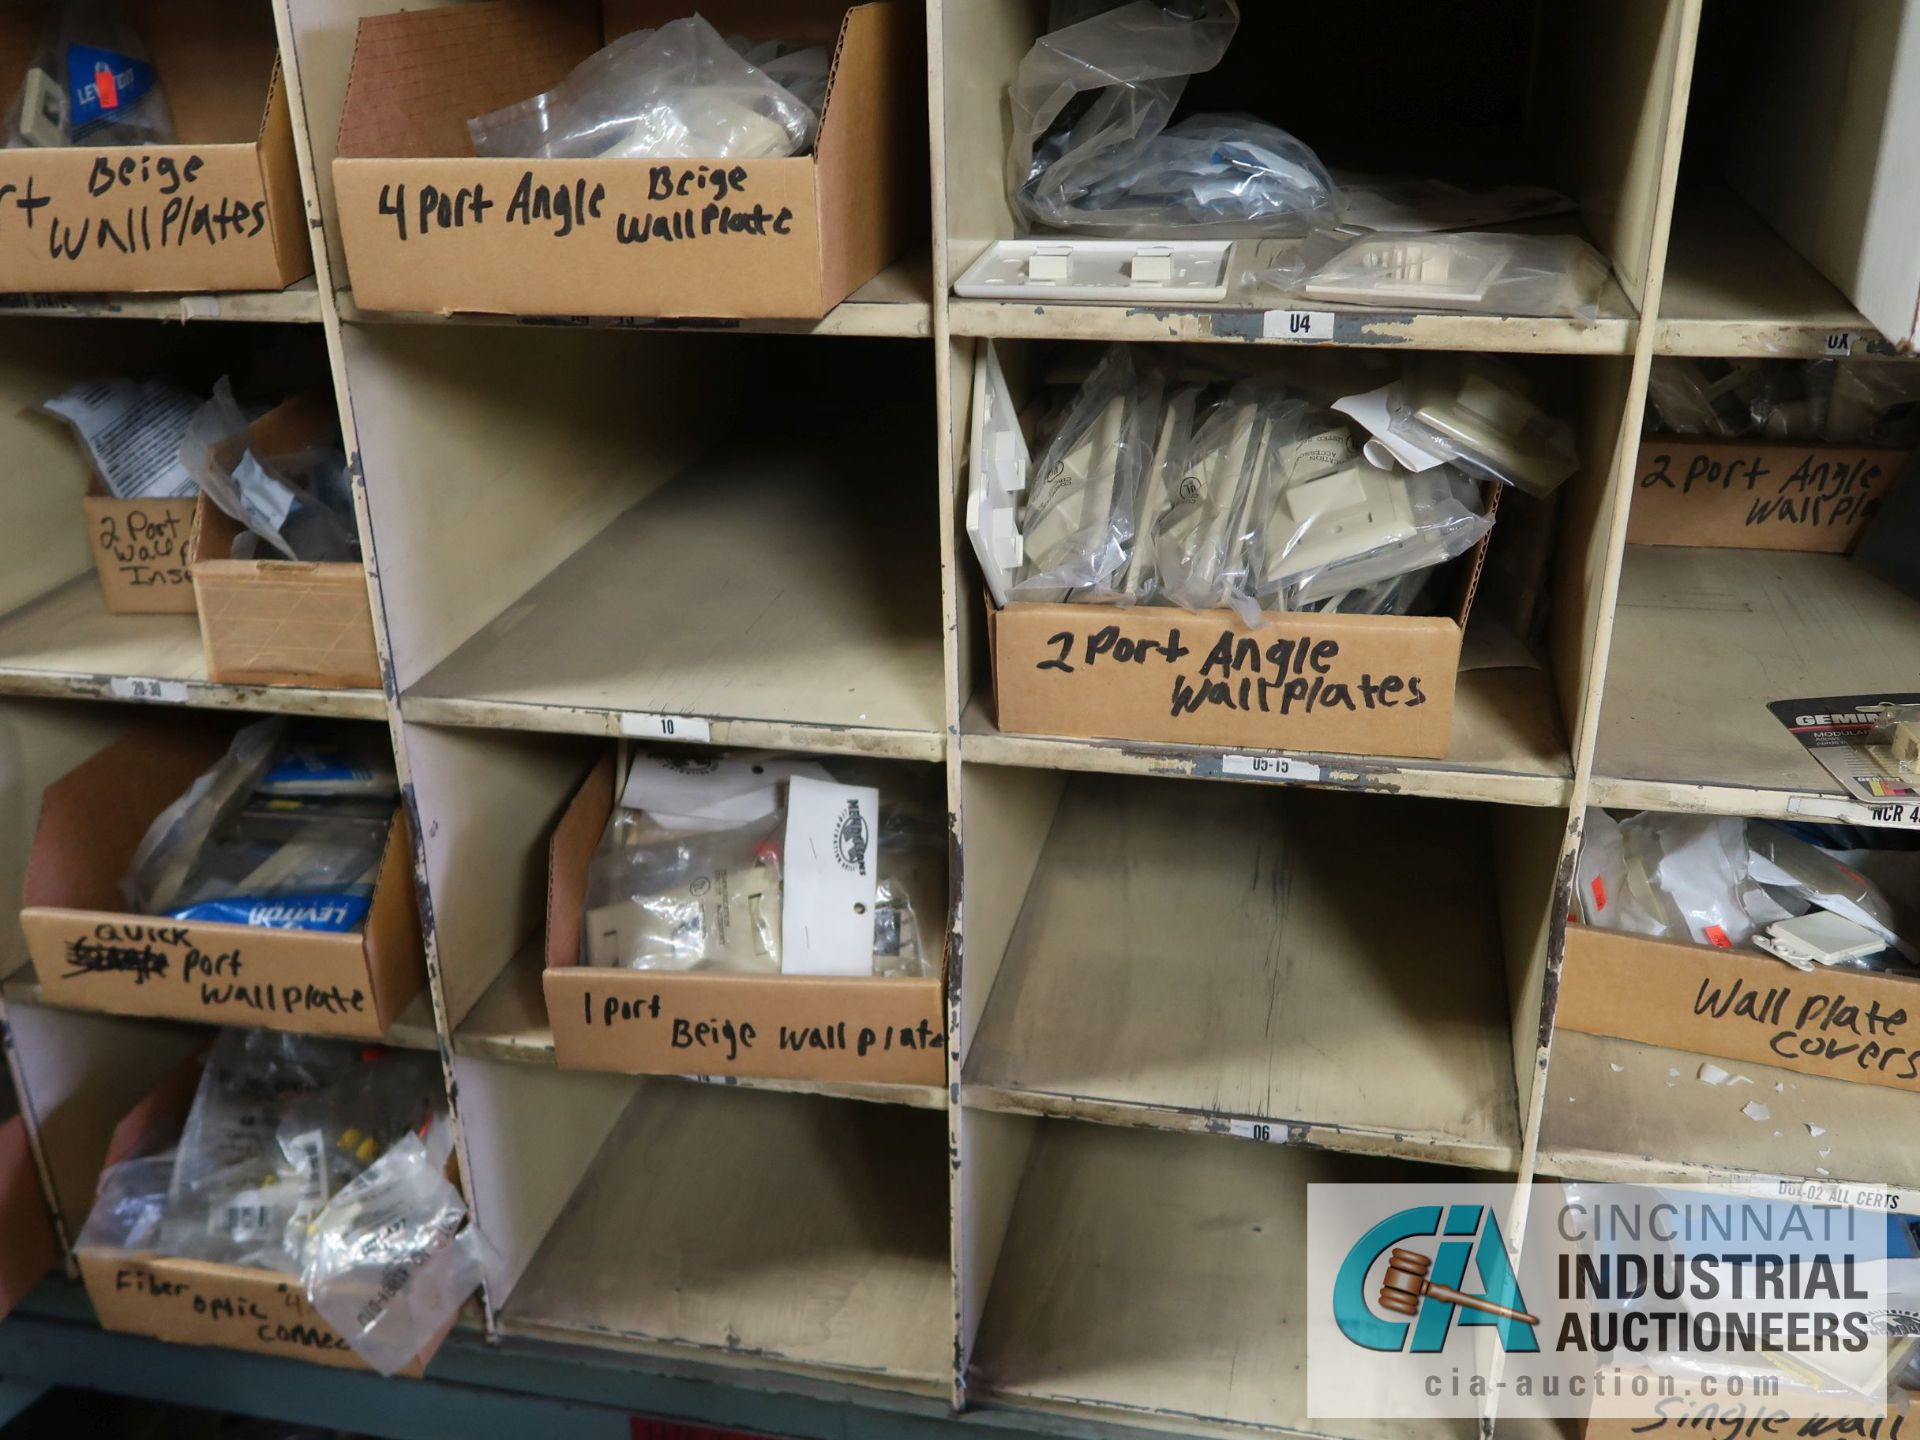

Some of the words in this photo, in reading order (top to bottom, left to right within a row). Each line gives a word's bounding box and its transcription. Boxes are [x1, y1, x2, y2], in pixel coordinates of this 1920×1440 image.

[88, 155, 204, 197] Beige
[378, 183, 407, 240] 4
[506, 171, 605, 237] Angle
[1290, 313, 1311, 334] U4
[1641, 455, 1676, 488] 2
[1778, 454, 1882, 500] Angle
[101, 516, 118, 549] 2
[1036, 631, 1075, 672] 2
[1199, 630, 1340, 689] Angle
[661, 719, 674, 735] 10
[1795, 713, 1880, 726] GEMIN
[1872, 805, 1904, 823] NCR
[1909, 806, 1920, 824] 4
[1694, 977, 1791, 1026] Wall
[671, 1017, 757, 1061] Beige
[1253, 1124, 1270, 1141] 06
[1829, 1187, 1849, 1204] ALL
[1856, 1191, 1900, 1209] CERTS
[115, 1270, 190, 1297] Fiber
